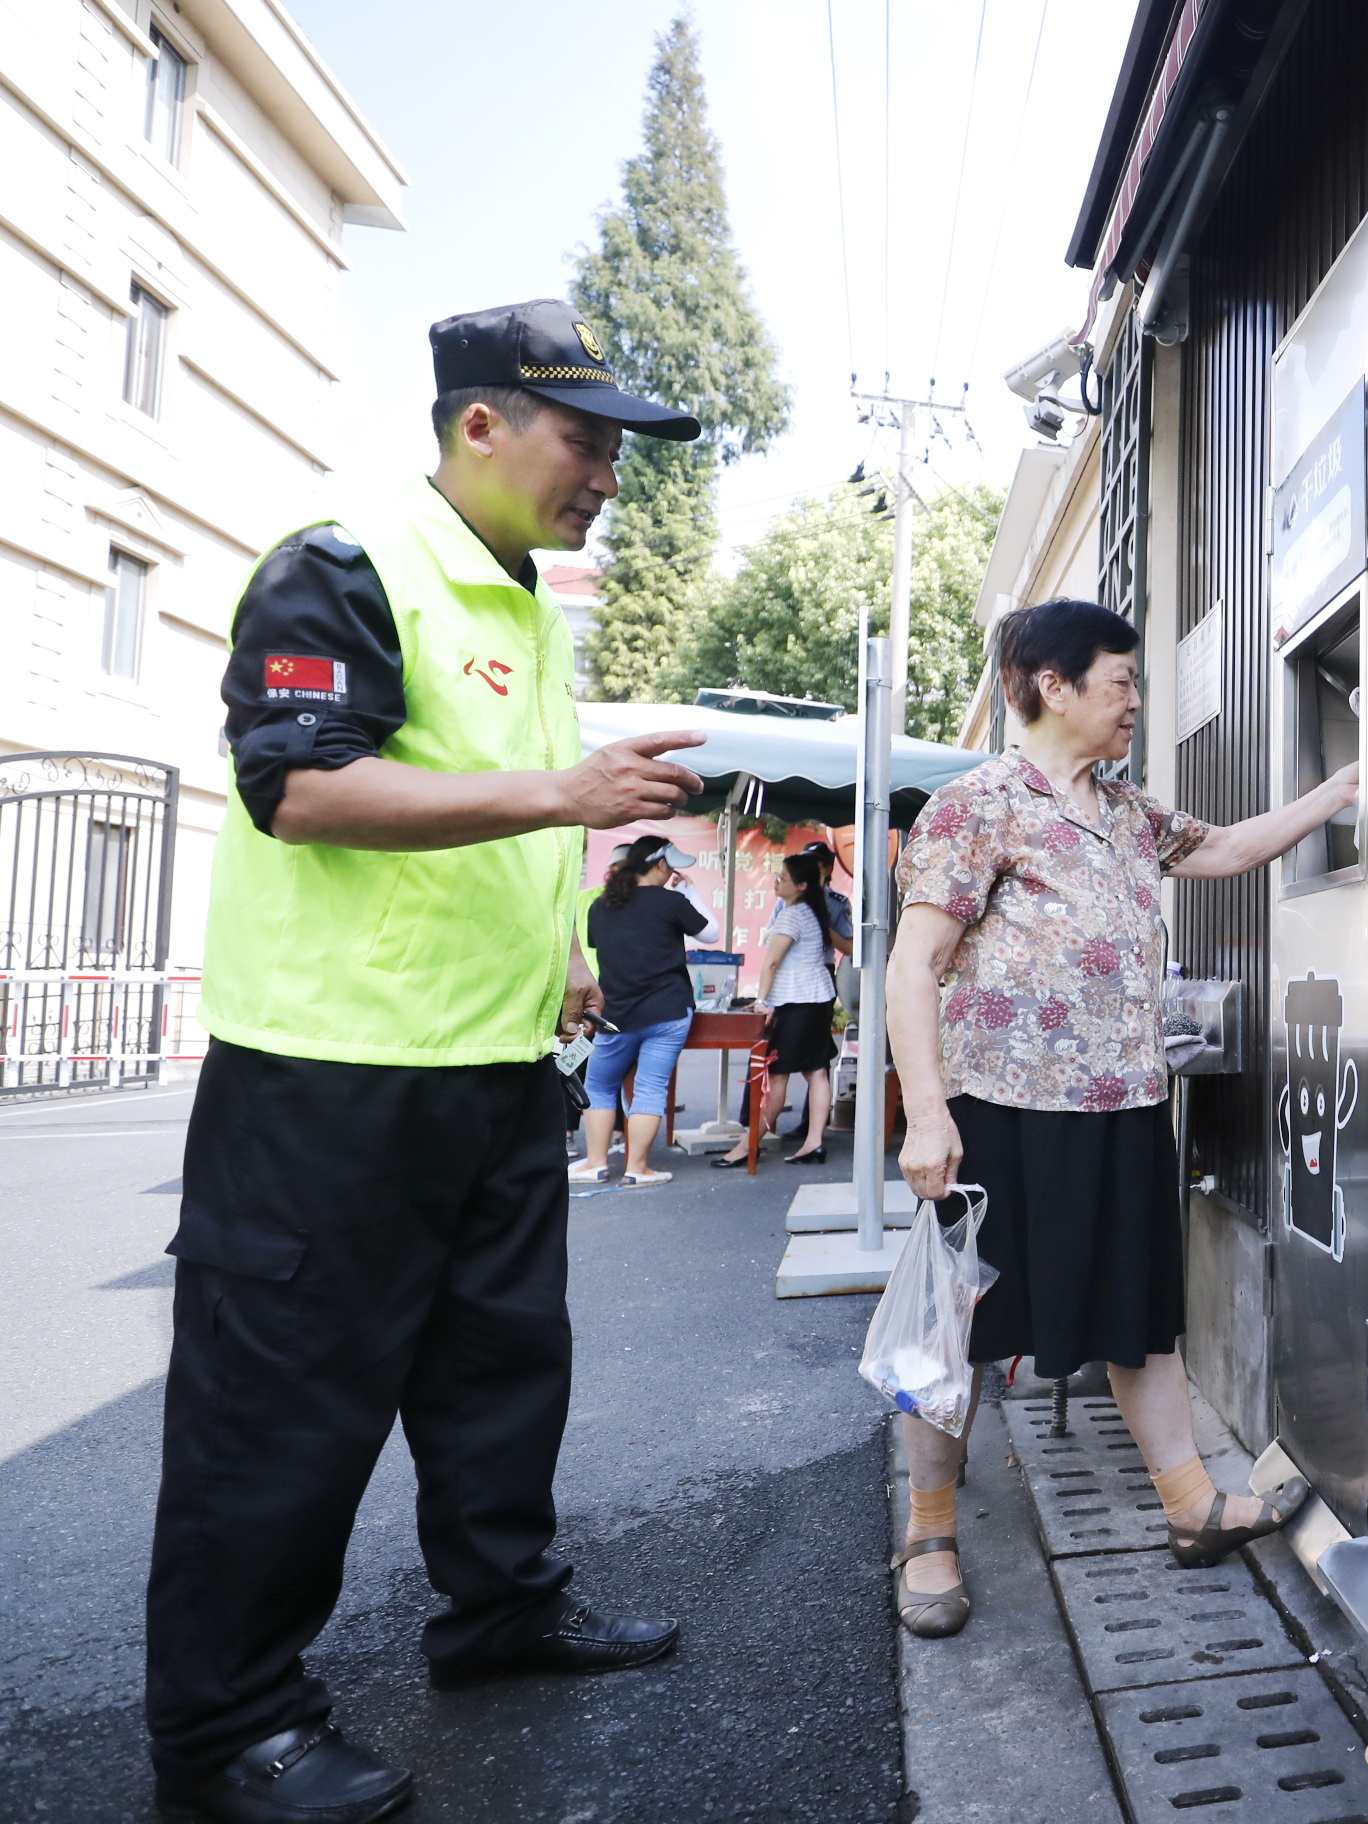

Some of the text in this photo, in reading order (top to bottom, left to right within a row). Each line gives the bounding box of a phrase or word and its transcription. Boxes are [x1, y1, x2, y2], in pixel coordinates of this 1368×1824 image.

[1300, 434, 1342, 513] 干垃圾
[266, 687, 341, 702] 保安 CHINESE
